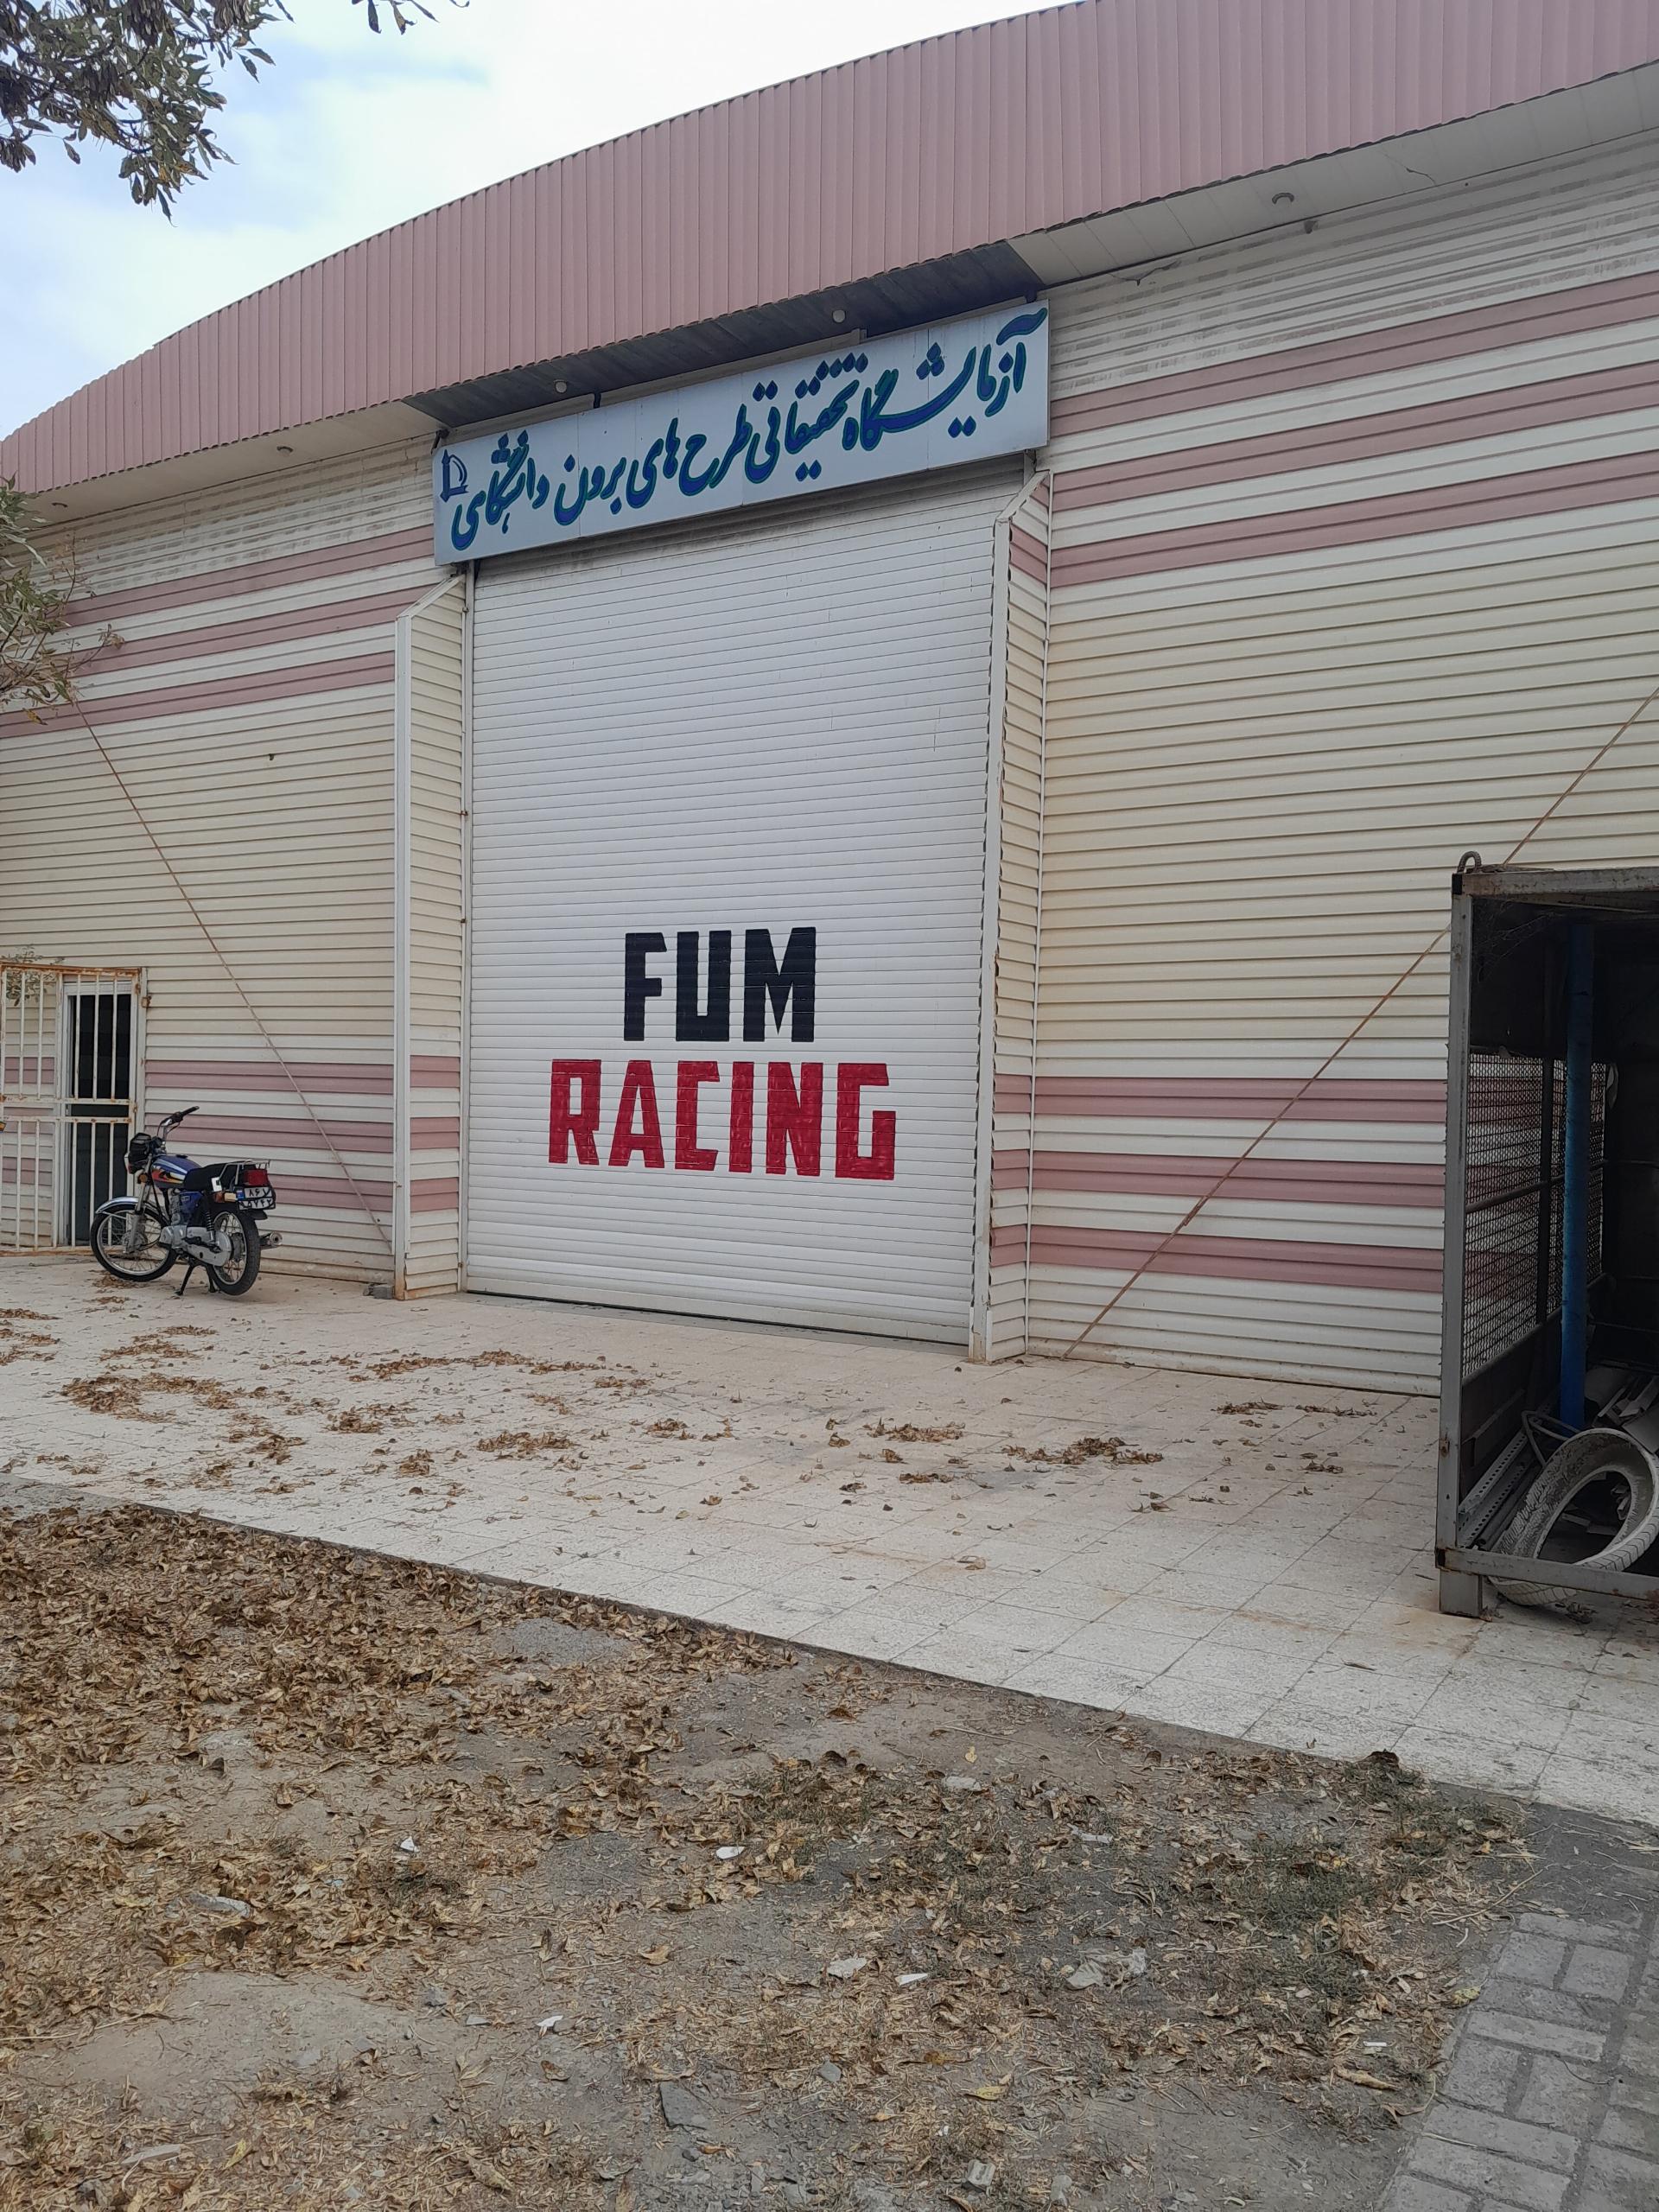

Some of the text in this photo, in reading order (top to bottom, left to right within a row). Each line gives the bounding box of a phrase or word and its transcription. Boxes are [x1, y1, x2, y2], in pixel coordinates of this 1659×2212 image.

[451, 308, 1048, 551] آزمایشگاه تحقیقاتی طرح های برون دانشگاهی
[623, 926, 817, 1043] FUM
[548, 1058, 897, 1181] RACING
